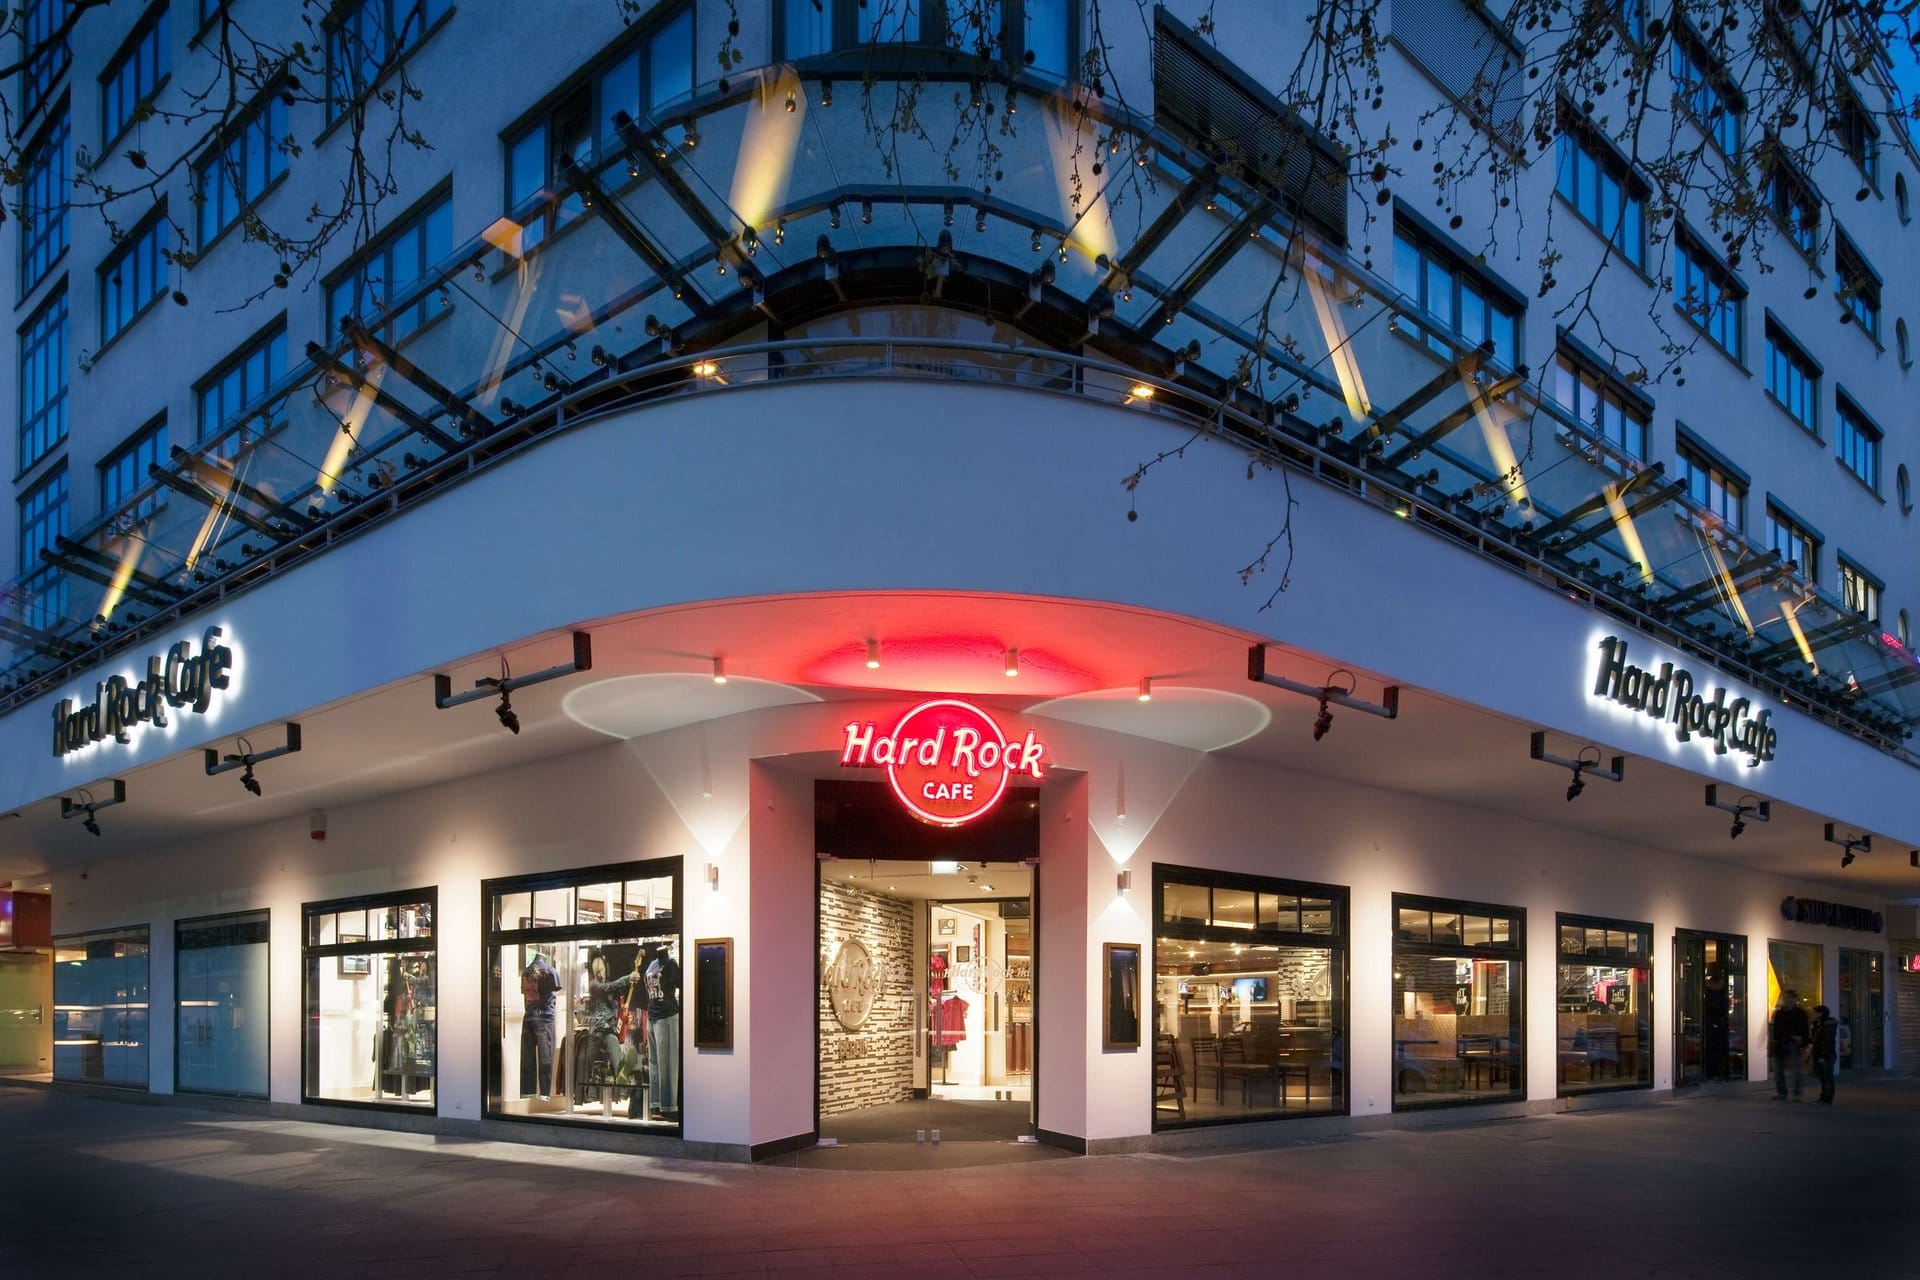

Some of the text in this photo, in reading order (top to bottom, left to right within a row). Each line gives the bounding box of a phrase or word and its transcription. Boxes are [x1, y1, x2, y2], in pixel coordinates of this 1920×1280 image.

[52, 625, 233, 757] Hard Rock Cafe
[1594, 635, 1777, 768] Hard Rock Cafe
[841, 721, 1046, 779] Hard Rock
[922, 781, 974, 801] CAFE
